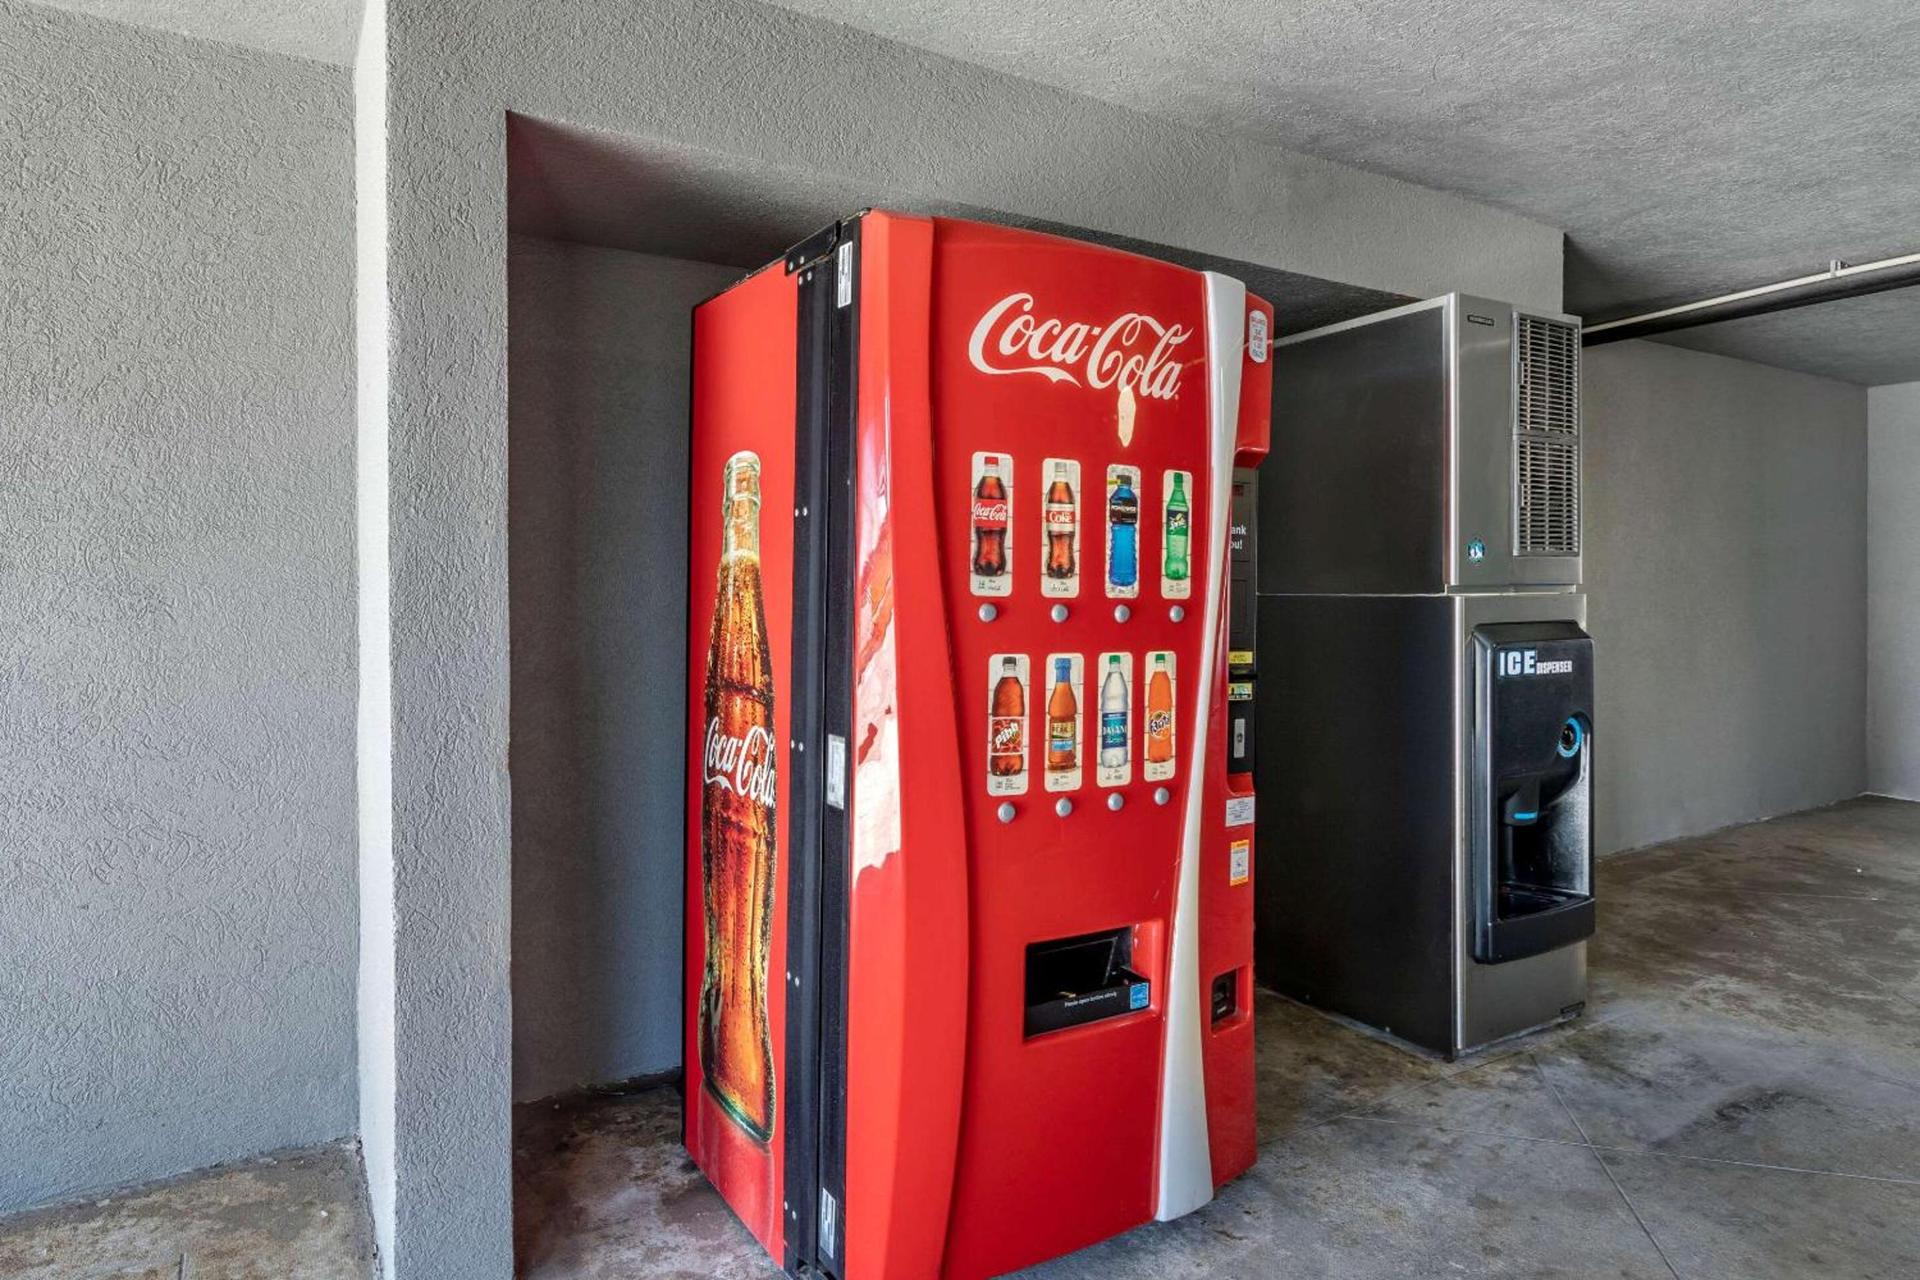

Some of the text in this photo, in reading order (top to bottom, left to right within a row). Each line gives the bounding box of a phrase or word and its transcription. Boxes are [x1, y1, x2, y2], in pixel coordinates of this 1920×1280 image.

[968, 292, 1194, 400] Coca-Cola
[974, 502, 1007, 521] Coca-Cola
[1049, 511, 1073, 524] Coke
[1231, 525, 1246, 535] ank
[1230, 539, 1243, 550] ou!
[1499, 650, 1573, 676] ICE DISPENSER
[705, 716, 775, 808] Coca-Cola
